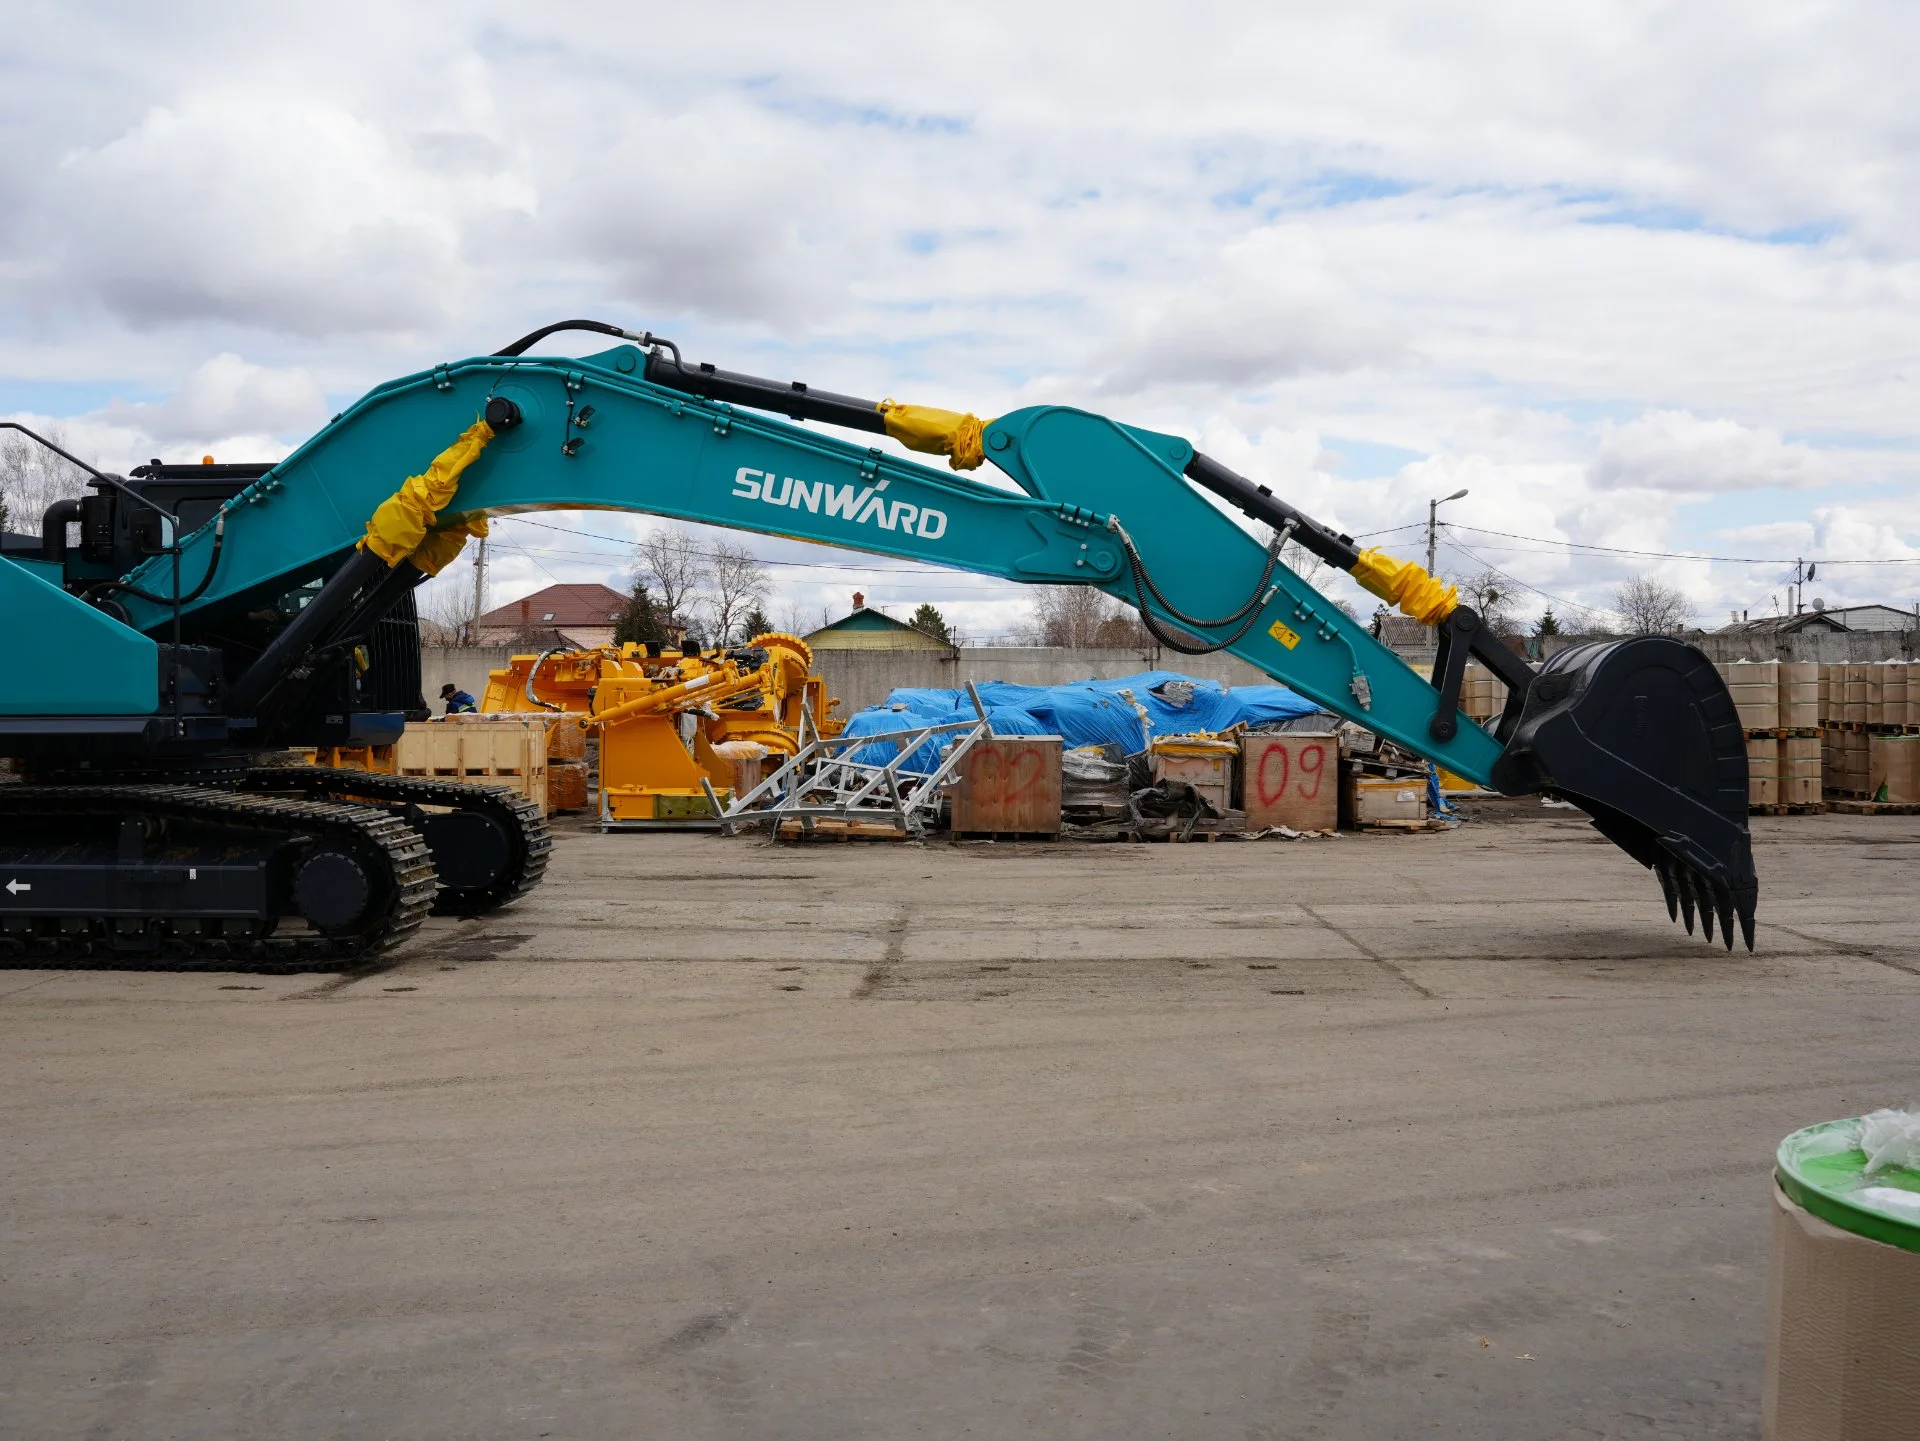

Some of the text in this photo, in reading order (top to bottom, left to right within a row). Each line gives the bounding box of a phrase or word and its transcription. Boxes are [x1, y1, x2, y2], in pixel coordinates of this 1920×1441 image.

[732, 467, 948, 540] SUNWARD
[969, 746, 1050, 805] 02
[1257, 743, 1326, 807] 09
